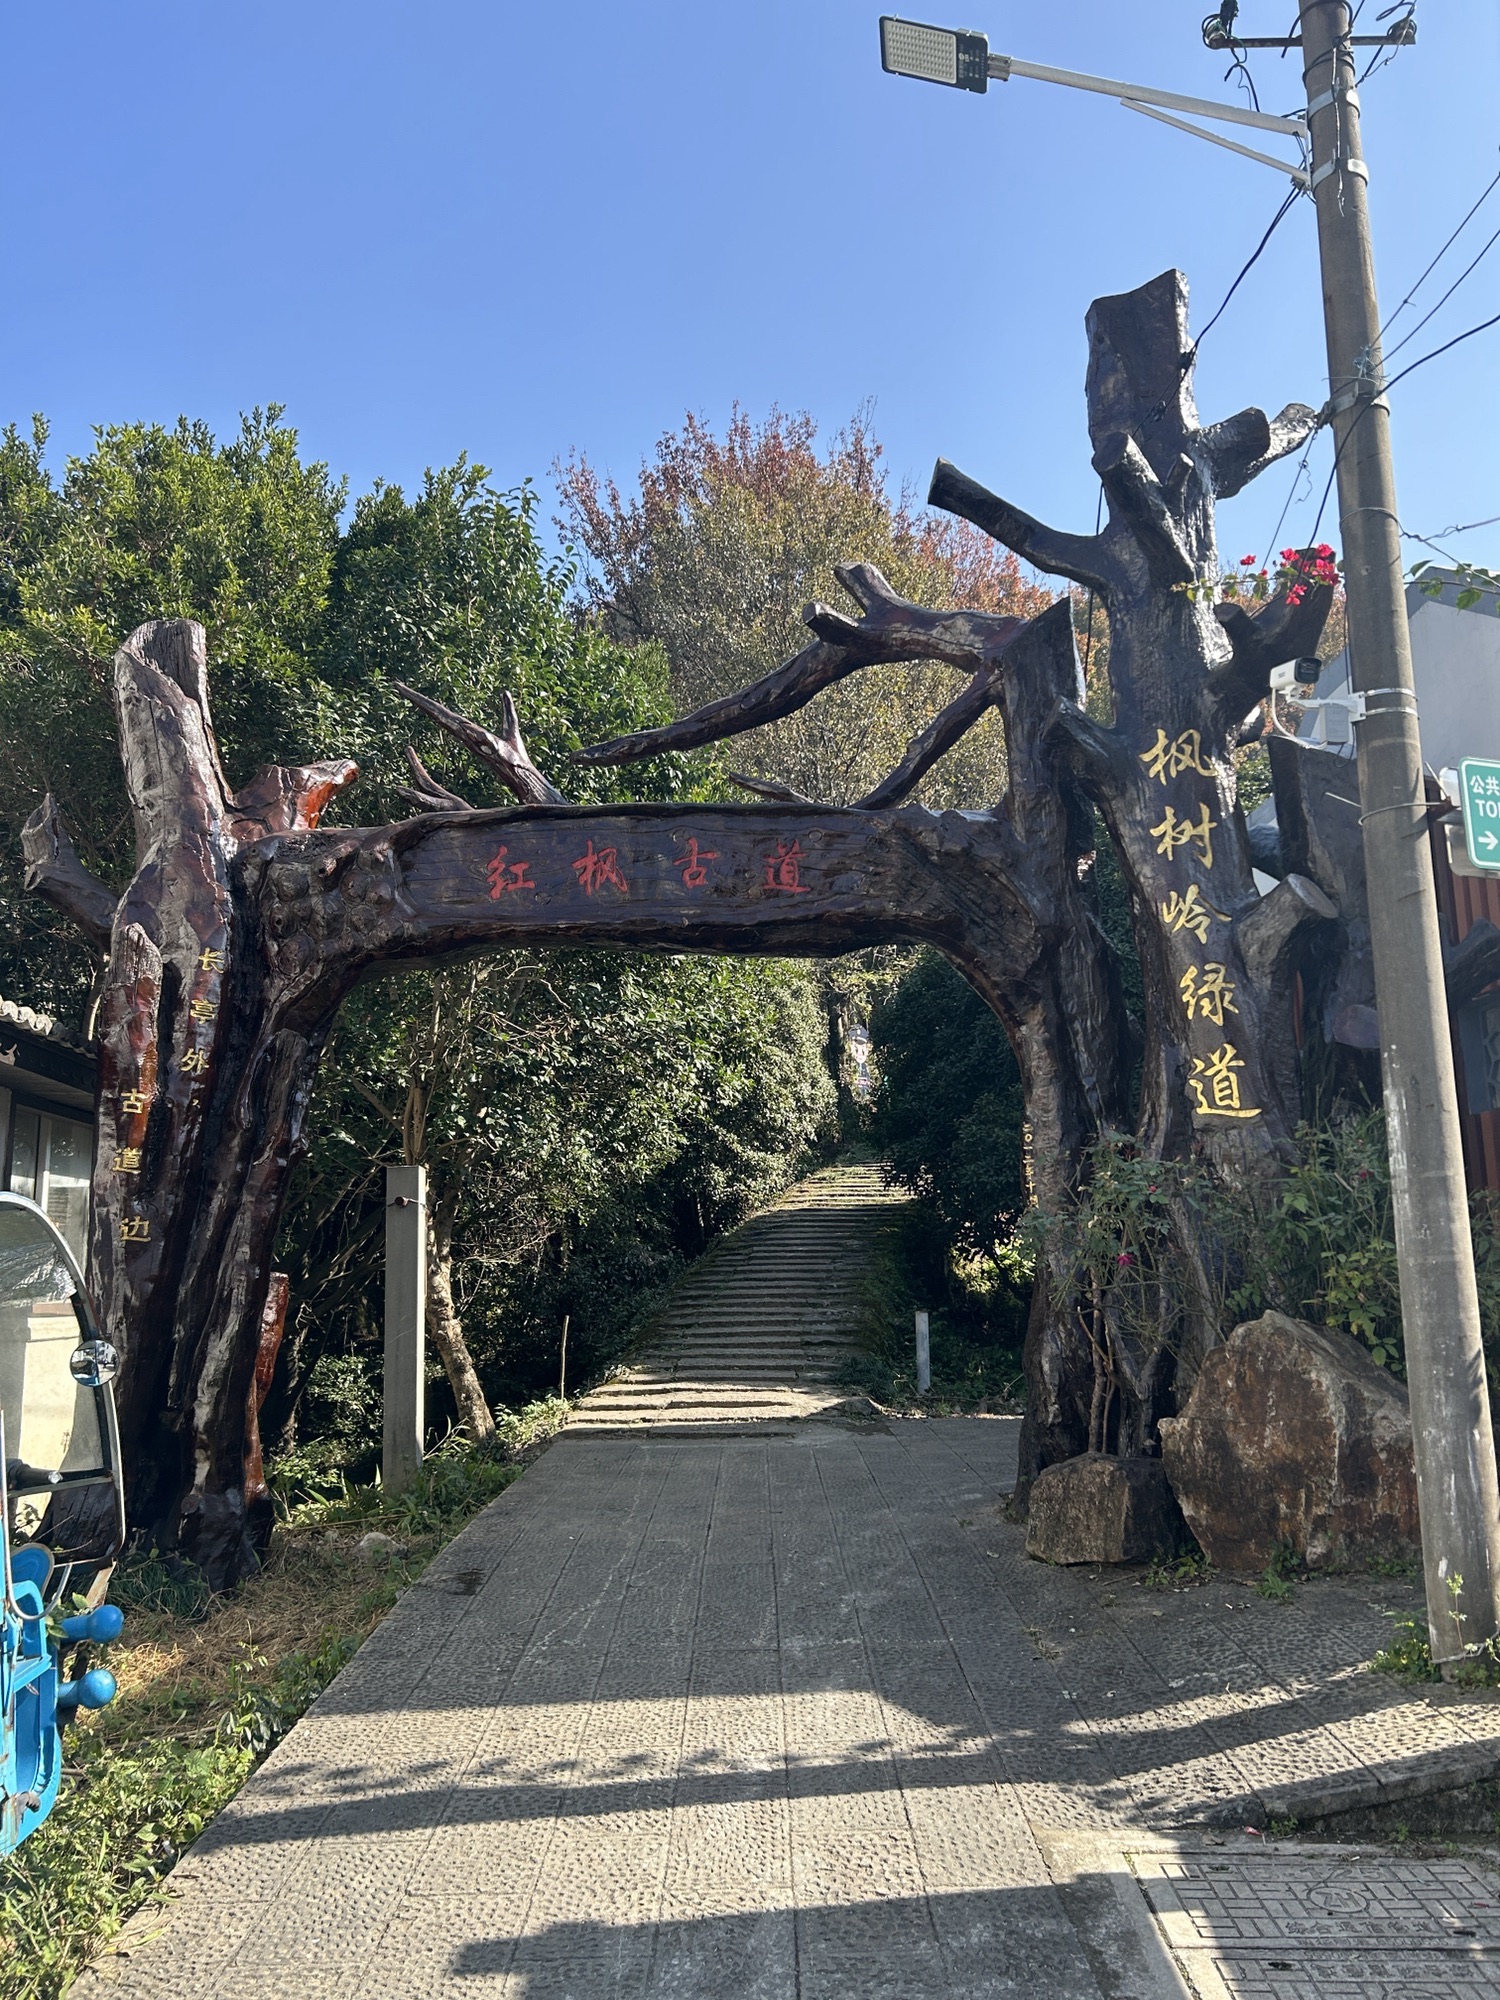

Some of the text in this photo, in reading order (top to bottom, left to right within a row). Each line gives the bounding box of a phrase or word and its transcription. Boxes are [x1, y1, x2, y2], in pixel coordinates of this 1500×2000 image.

[1470, 775, 1500, 796] 公共
[486, 837, 811, 899] 红枫古道
[1140, 728, 1262, 1118] 枫树岭绿道
[181, 947, 225, 1074] 长亭外
[112, 1088, 152, 1243] 古道边
